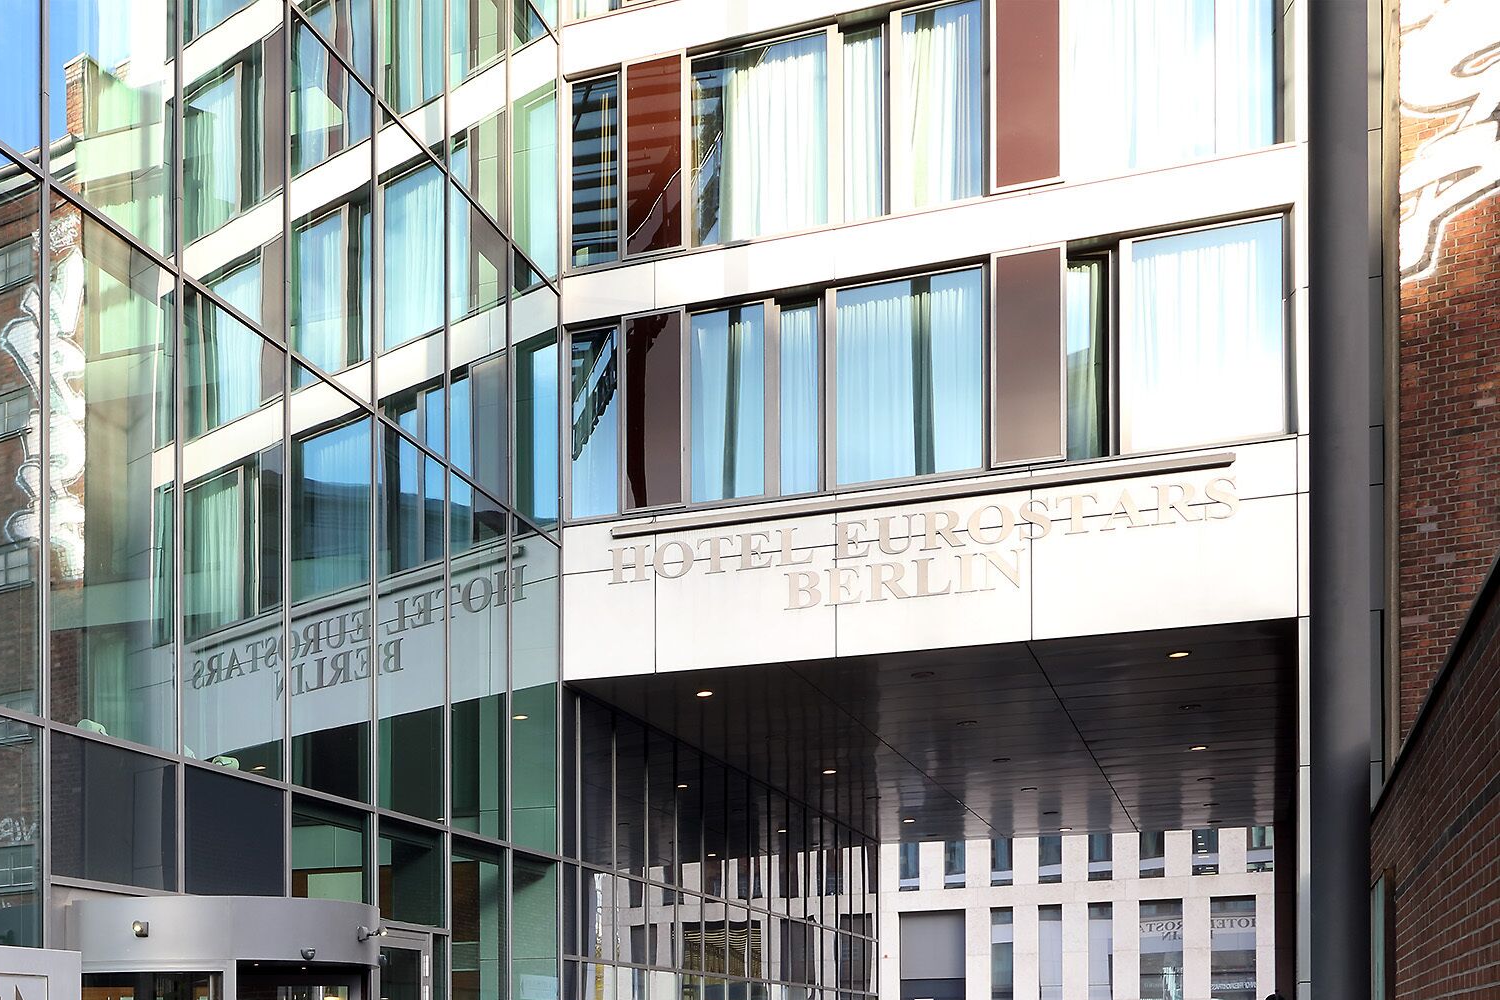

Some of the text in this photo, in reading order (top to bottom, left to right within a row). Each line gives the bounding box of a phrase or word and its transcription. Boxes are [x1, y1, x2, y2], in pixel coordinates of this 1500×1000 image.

[607, 474, 1239, 586] HOTEL EUROSTARS
[784, 547, 1025, 612] BERLIN
